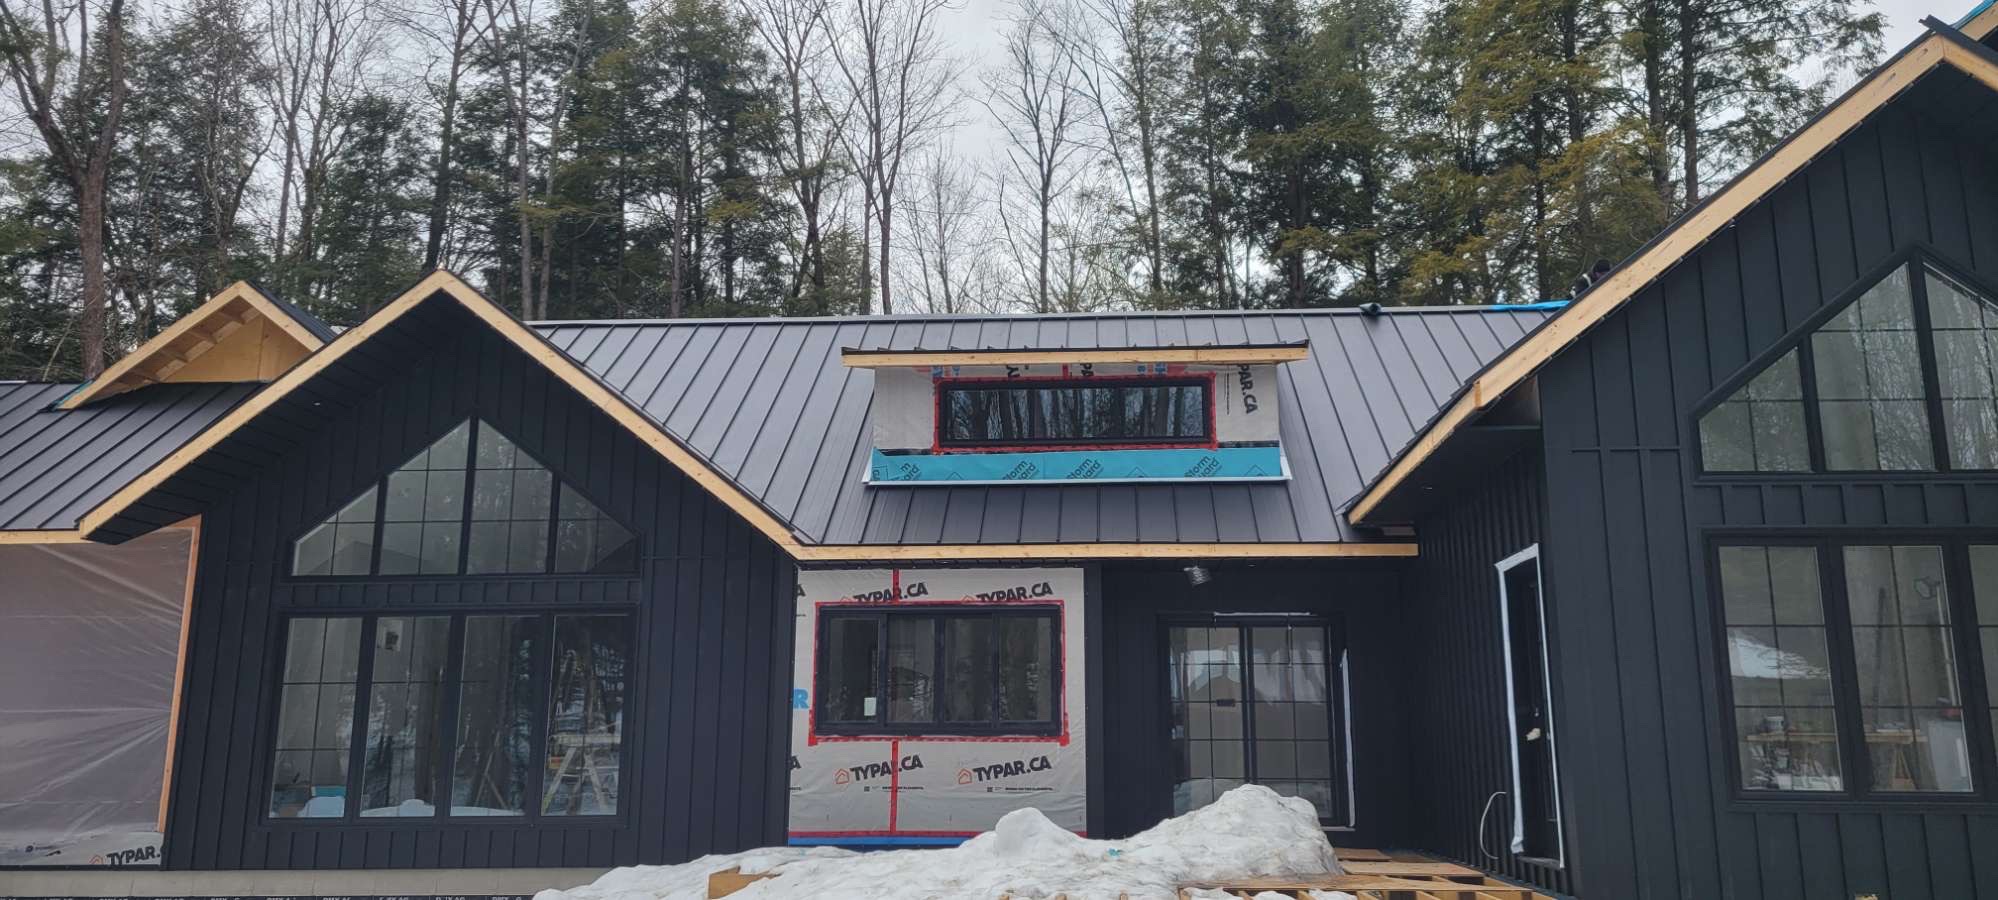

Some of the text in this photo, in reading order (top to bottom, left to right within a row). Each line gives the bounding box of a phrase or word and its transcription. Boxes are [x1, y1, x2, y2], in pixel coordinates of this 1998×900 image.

[1236, 363, 1258, 414] PAR.CA
[849, 754, 923, 781] TYPA.CA
[972, 755, 1052, 782] TYPAR.CA
[106, 845, 160, 865] TYPAR.
